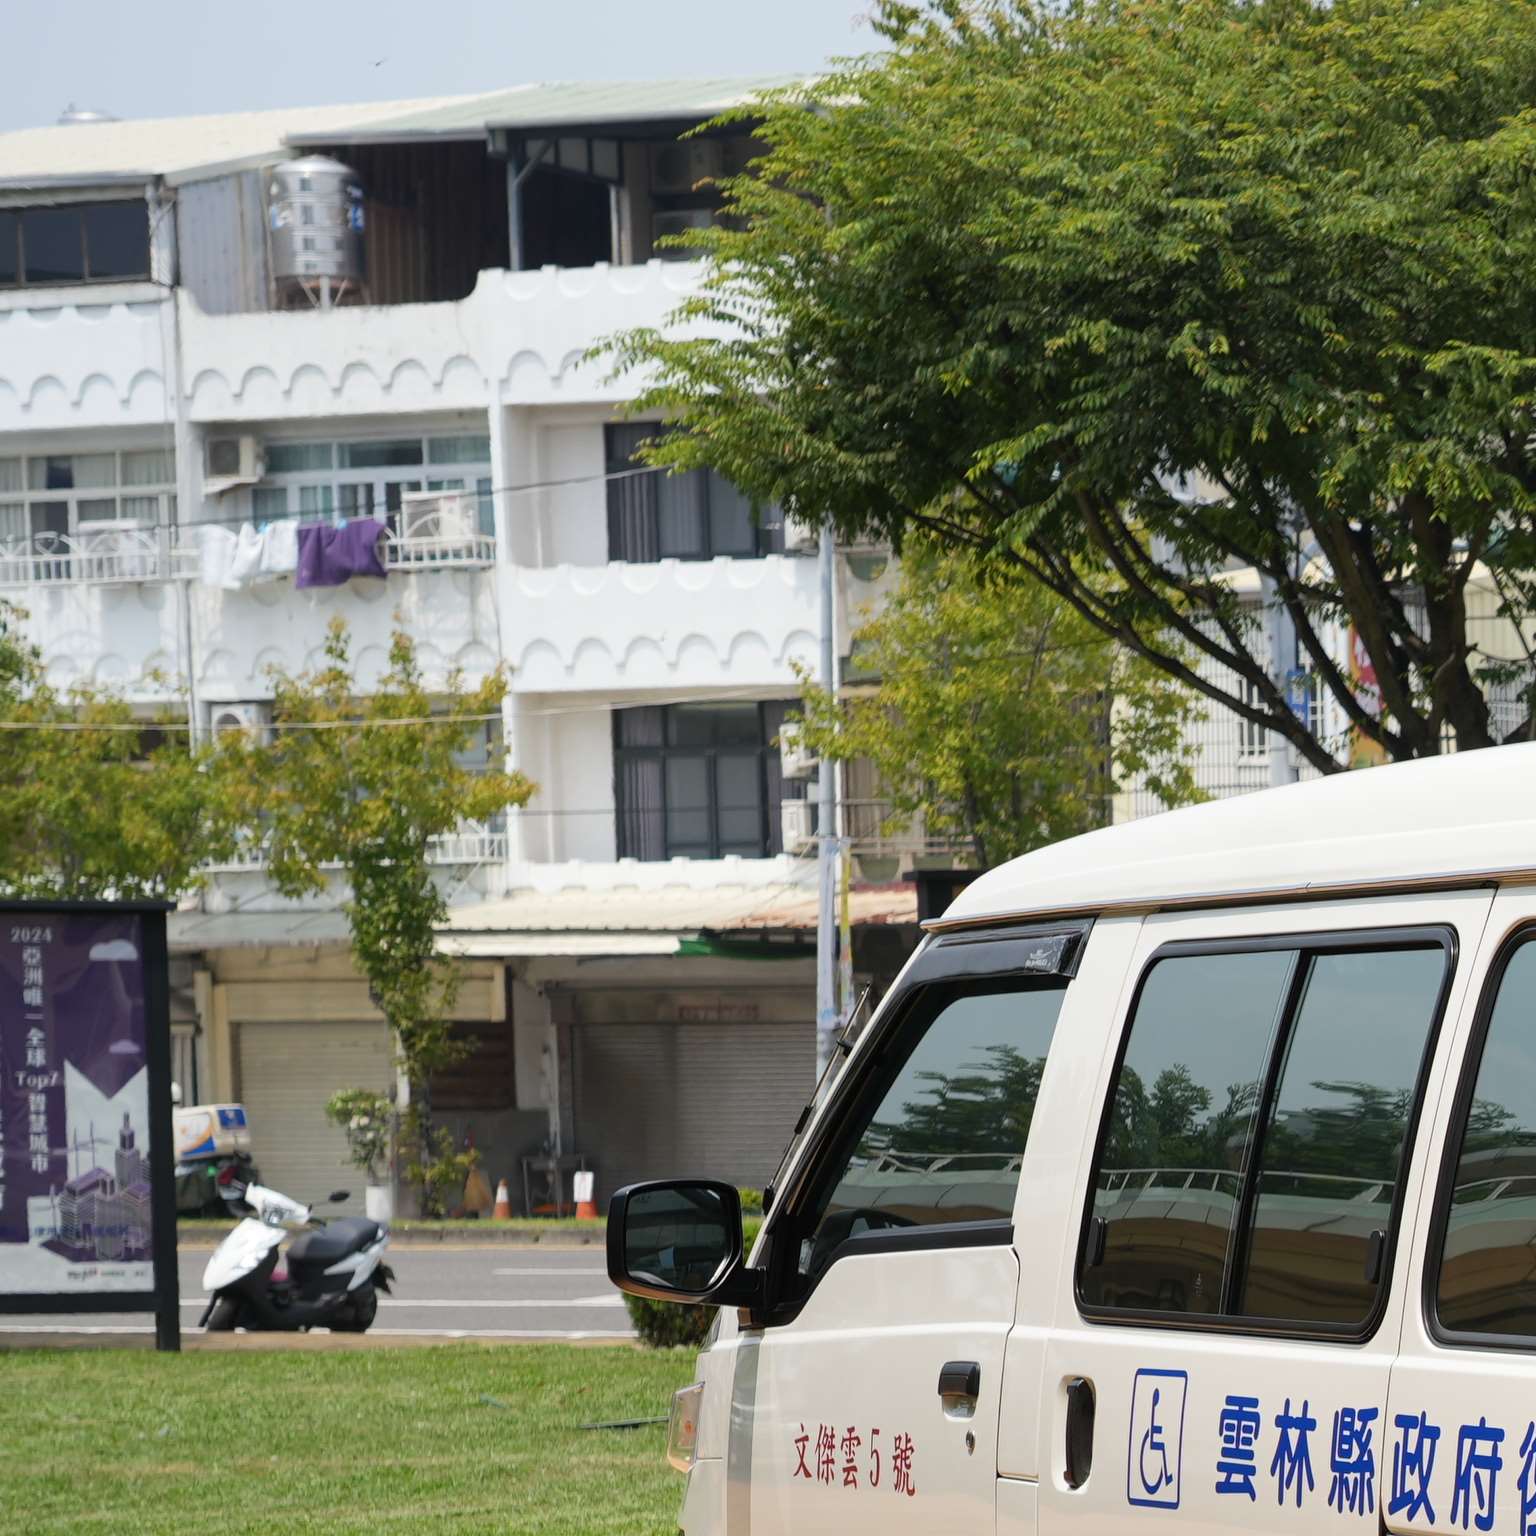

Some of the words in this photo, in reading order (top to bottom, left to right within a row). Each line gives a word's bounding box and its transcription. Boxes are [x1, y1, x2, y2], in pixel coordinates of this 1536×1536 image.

[10, 926, 53, 944] 2024
[15, 1070, 59, 1090] Top7
[28, 1093, 49, 1174] 智慧城市
